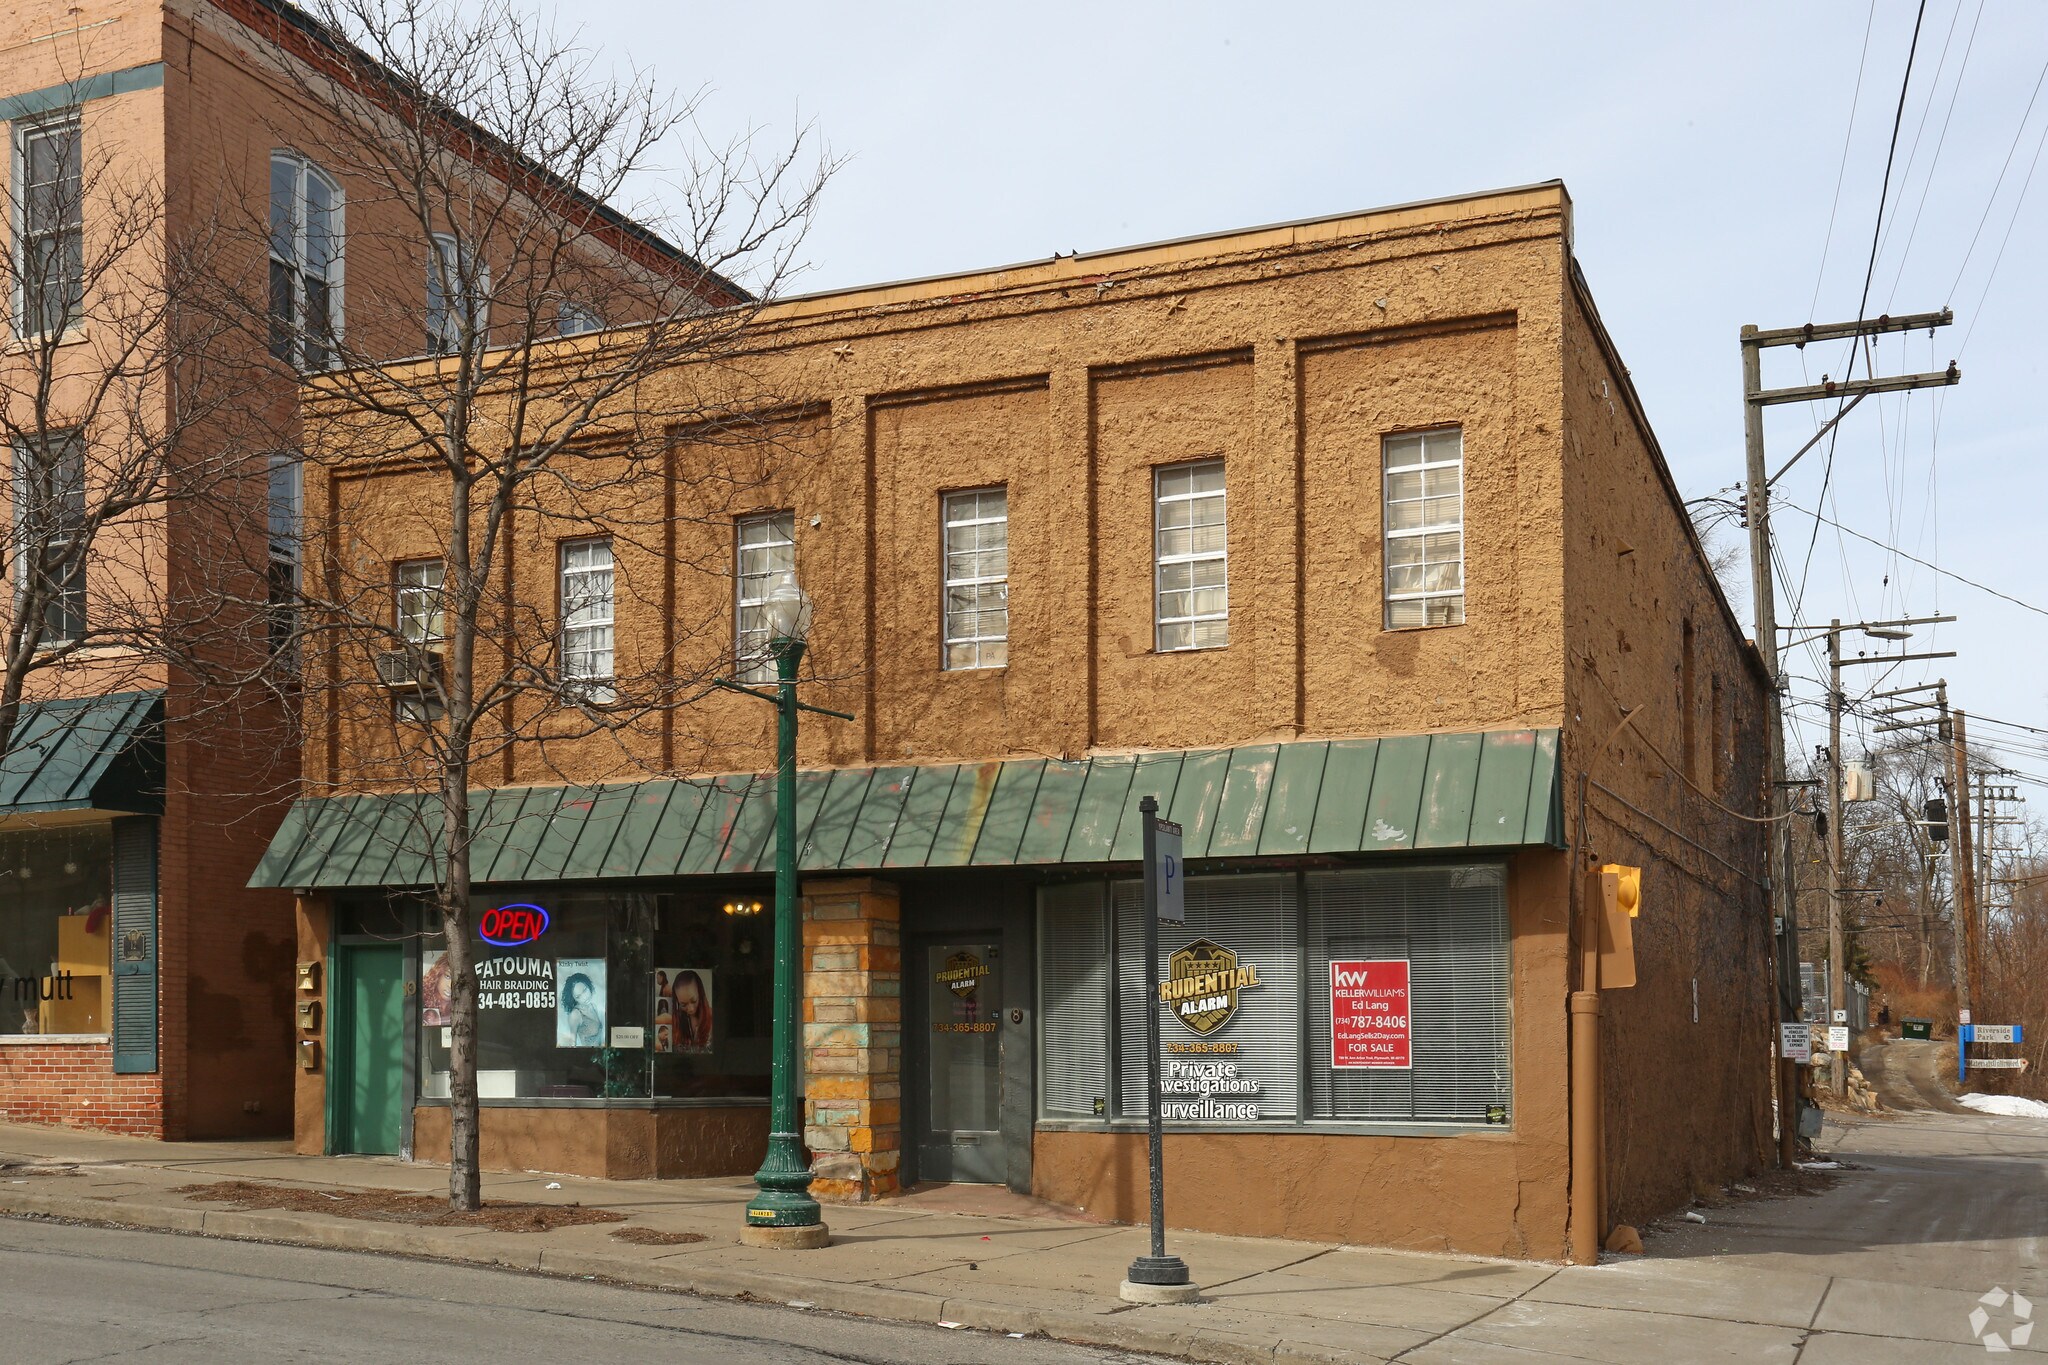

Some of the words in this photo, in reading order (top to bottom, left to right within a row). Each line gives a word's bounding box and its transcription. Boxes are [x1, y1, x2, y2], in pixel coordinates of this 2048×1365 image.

[1165, 855, 1175, 894] P
[481, 909, 543, 941] OPEN
[474, 957, 553, 980] FATOUMA
[936, 965, 990, 982] PRUDENTIAL
[1335, 965, 1367, 987] kw
[15, 970, 73, 1001] mutt
[480, 981, 501, 989] HAIR
[504, 981, 549, 990] BRAIDING
[951, 979, 975, 990] ALARM
[1159, 966, 1260, 1002] RUDENTIAL
[478, 992, 555, 1009] 34-483-0855
[1181, 995, 1228, 1016] ALARM
[1352, 1001, 1363, 1009] Ed
[1366, 1001, 1388, 1011] Lang
[1012, 1008, 1020, 1021] 8
[1336, 1017, 1350, 1025] (734)
[1351, 1016, 1406, 1028] 787-8406
[933, 1023, 996, 1032] 734-365-8807
[1337, 1032, 1405, 1040] EdLangSells2Day.com
[1167, 1043, 1238, 1053] 734-365-8807
[1348, 1044, 1367, 1052] FOR
[1371, 1043, 1394, 1052] SALE
[1169, 1061, 1236, 1077] Private
[1161, 1100, 1258, 1119] urveillance
